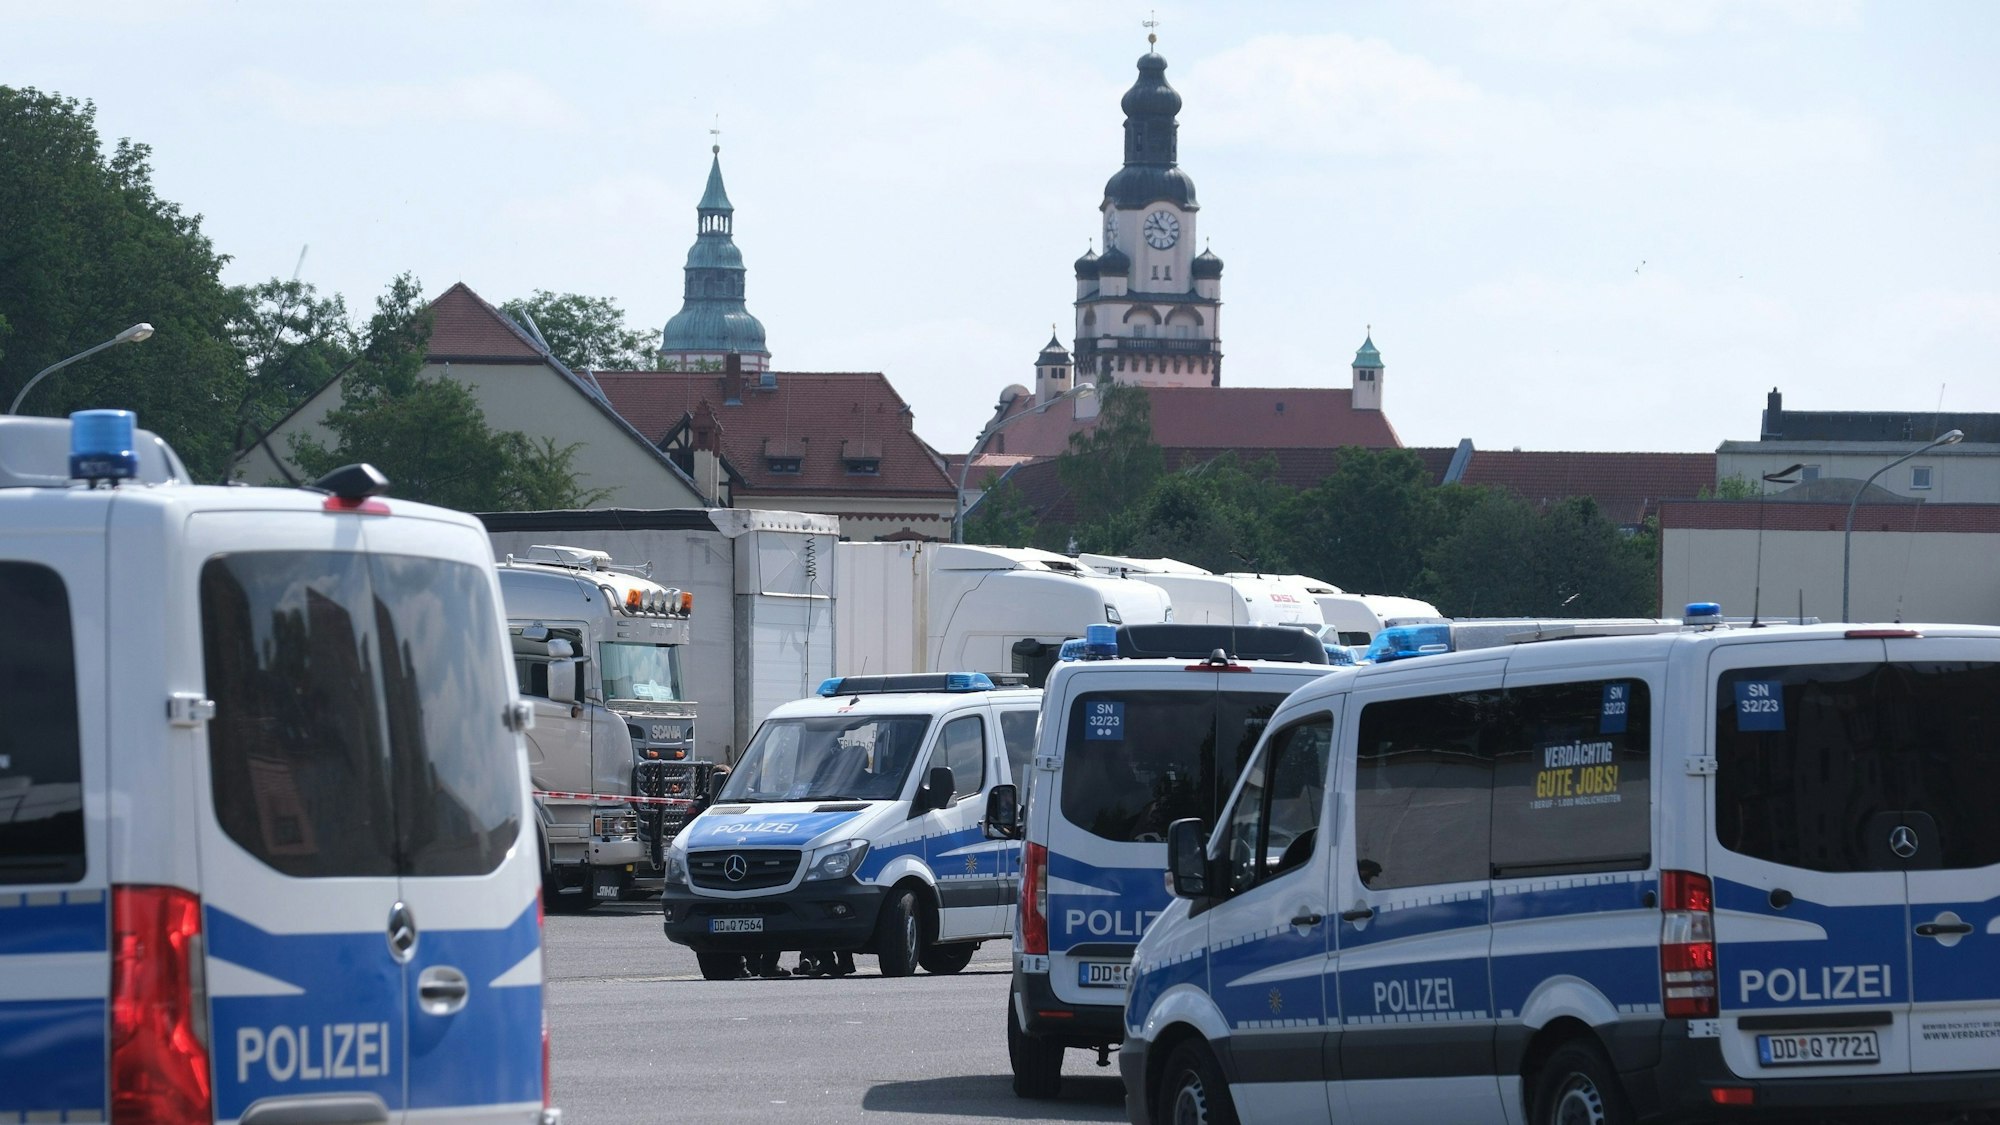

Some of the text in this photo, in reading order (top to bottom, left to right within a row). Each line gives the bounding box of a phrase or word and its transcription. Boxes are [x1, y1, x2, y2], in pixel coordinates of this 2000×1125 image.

[1609, 686, 1623, 699] SN
[1748, 683, 1769, 697] SN
[1096, 703, 1114, 714] SN
[1603, 701, 1626, 715] 32/23
[1741, 699, 1779, 713] 32/23
[1089, 715, 1120, 726] 32/23
[651, 724, 682, 739] SCANIA
[1544, 740, 1613, 768] VERDÄCHTIG
[1536, 765, 1619, 798] GUTE JOBS!
[712, 822, 800, 836] POLIZEI
[714, 920, 762, 931] DD Q 7564
[1090, 965, 1112, 982] DD
[1739, 964, 1892, 1003] POLIZEI
[1373, 977, 1455, 1014] POLIZEI
[236, 1021, 390, 1083] POLIZEI
[1771, 1035, 1876, 1060] DD Q 7721
